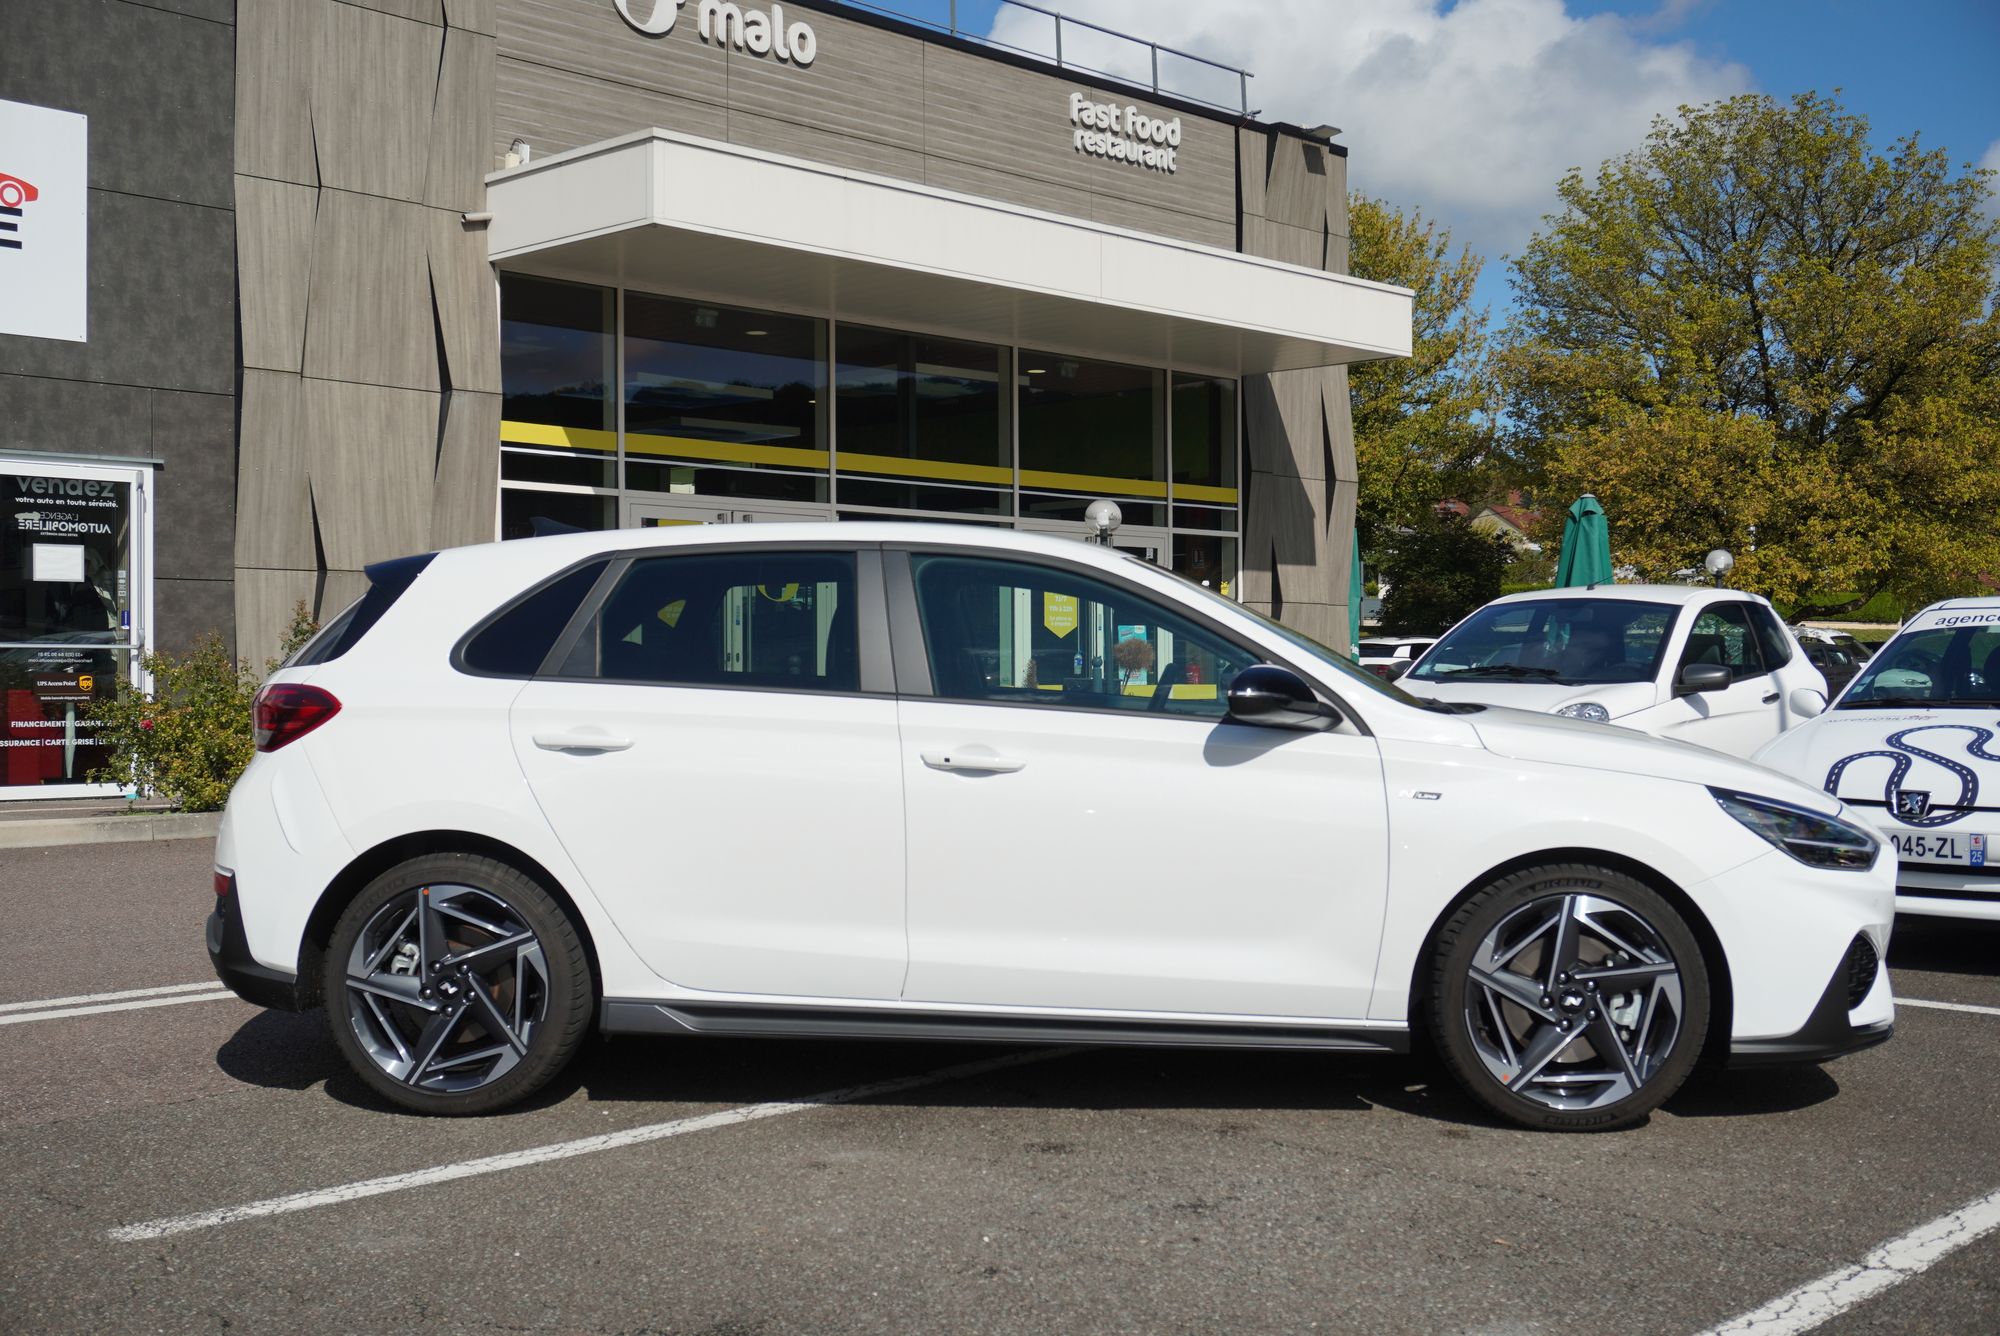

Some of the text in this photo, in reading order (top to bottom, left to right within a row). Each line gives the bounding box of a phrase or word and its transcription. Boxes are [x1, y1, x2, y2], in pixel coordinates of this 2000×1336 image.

[698, 0, 817, 65] malo
[1069, 92, 1181, 147] fast food
[1073, 129, 1177, 171] restaurant
[15, 477, 115, 498] vendez
[15, 496, 35, 504] votre
[88, 499, 119, 508] sérénité.
[1934, 614, 2000, 627] agenc
[45, 738, 70, 746] CARTE
[71, 738, 94, 746] GRISE
[1971, 851, 1982, 862] 25
